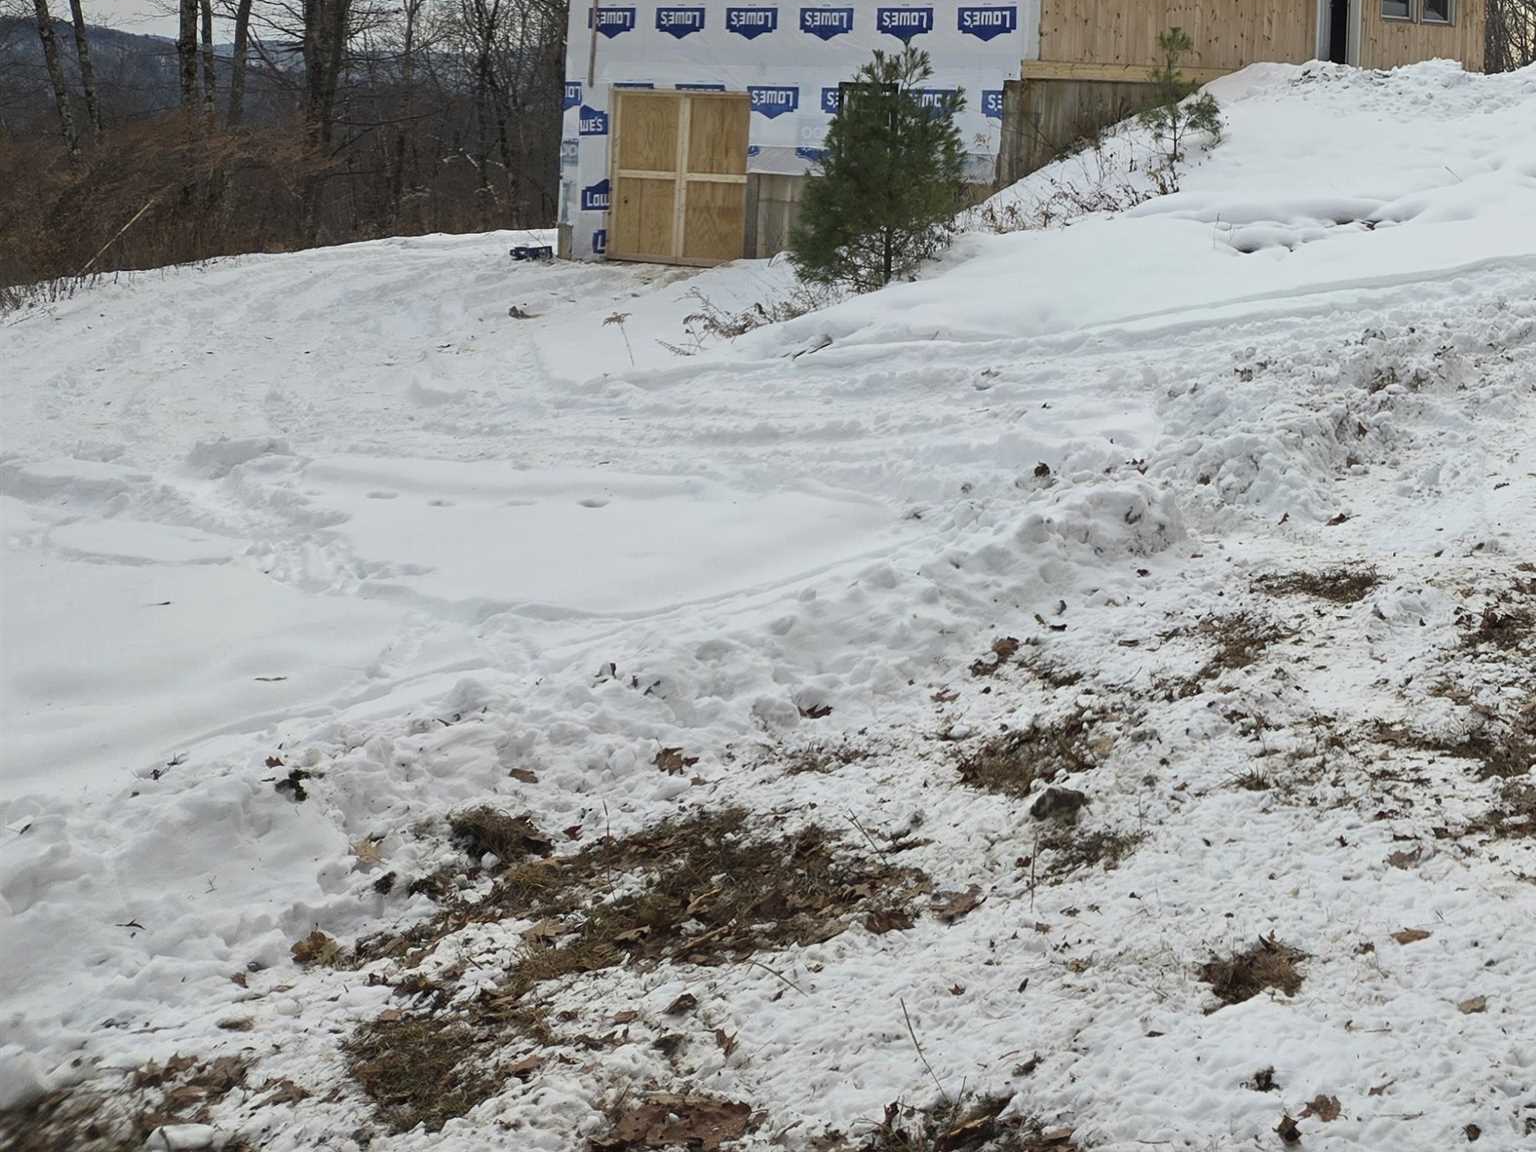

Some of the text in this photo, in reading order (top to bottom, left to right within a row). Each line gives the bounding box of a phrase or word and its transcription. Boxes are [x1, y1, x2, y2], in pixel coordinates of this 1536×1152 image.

[660, 11, 700, 27] LOWE'S
[731, 11, 773, 28] LOWE'S
[804, 11, 848, 28] LOWE'S
[882, 11, 927, 28] LOWE'S
[963, 11, 1011, 28] LOWE'S
[752, 89, 793, 106] LOWE'S
